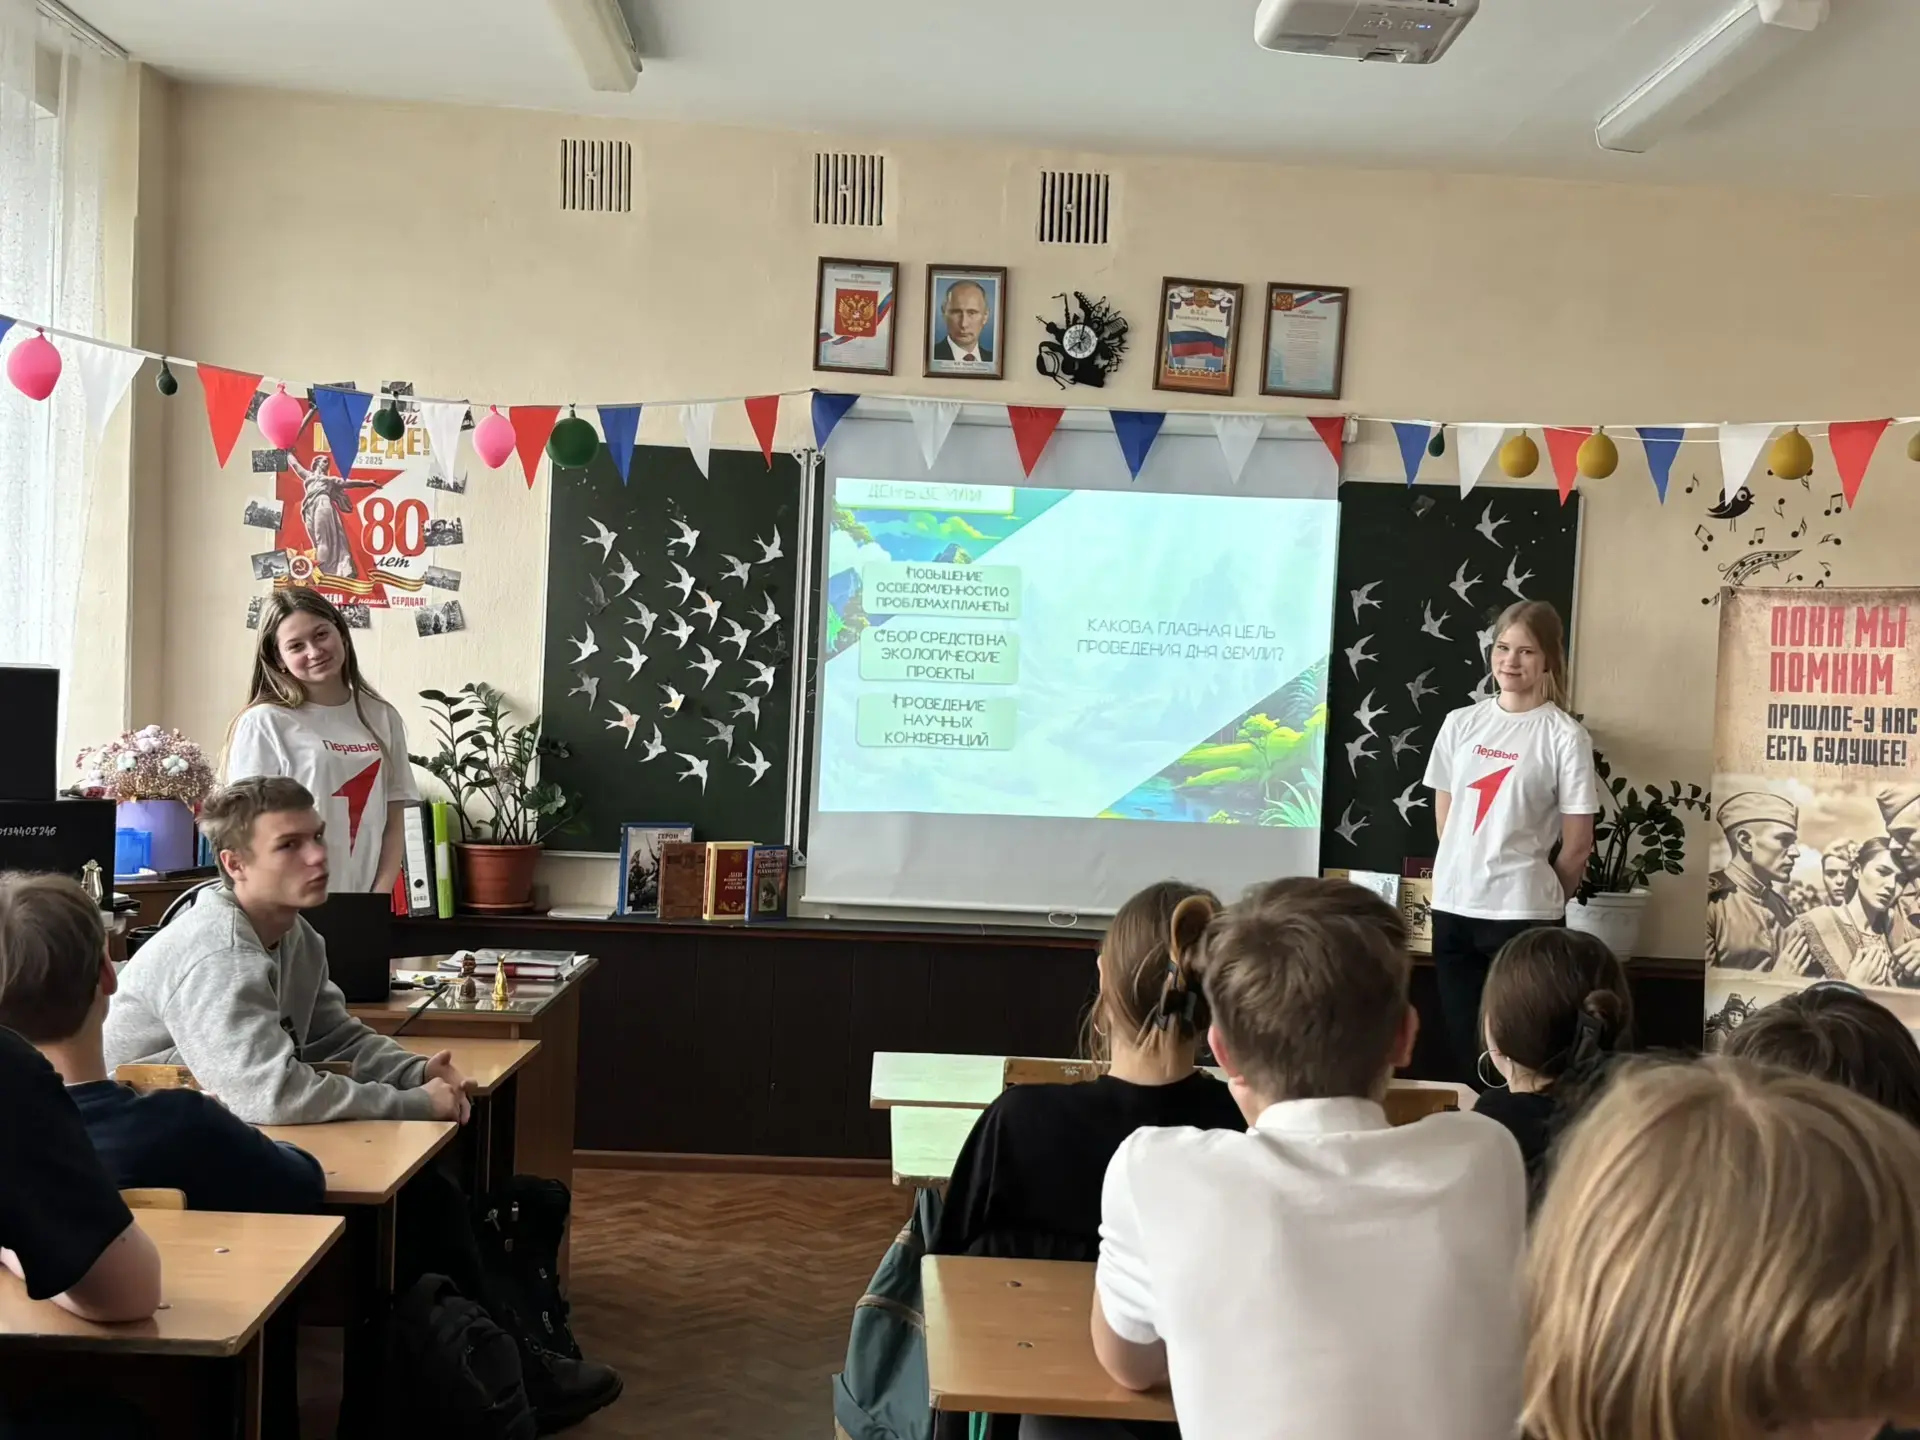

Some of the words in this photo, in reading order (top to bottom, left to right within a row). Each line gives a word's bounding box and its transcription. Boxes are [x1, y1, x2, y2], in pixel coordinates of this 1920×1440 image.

[362, 496, 430, 558] 80
[373, 554, 410, 568] лет
[906, 567, 983, 582] ПОВЫШЕНИЕ
[876, 581, 998, 597] ОСВЕДОМЛЕННОСТИ
[1000, 587, 1010, 598] О
[391, 596, 427, 607] СЕРДЦАХ!
[876, 596, 950, 610] ПРОБЛЕМАХ
[951, 599, 1010, 612] ПЛАНЕТЫ
[1087, 618, 1154, 635] КАКОВА
[1157, 620, 1231, 638] ГЛАВНАЯ
[1234, 624, 1276, 640] ЦЕЛЬ
[1770, 605, 1846, 648] ПОКА
[1855, 606, 1908, 648] МЫ
[873, 630, 917, 643] СБОР
[920, 631, 984, 646] СРЕДСТВ
[986, 634, 1008, 647] НА
[881, 647, 1001, 664] ЭКОЛОГИЧЕСКИЕ
[1077, 638, 1181, 657] ПРОВЕДЕНИЯ
[1184, 643, 1218, 660] ДНЯ
[1221, 645, 1285, 662] ЗЕМЛИ?
[906, 665, 975, 680] ПРОЕКТЫ
[1769, 651, 1895, 696] ПОМНИМ
[893, 695, 986, 712] ПРОВЕДЕНИЕ
[903, 713, 973, 729] НАУЧНЫХ
[1881, 706, 1919, 735] НАС
[322, 739, 381, 756] Первые
[884, 731, 989, 747] КОНФЕРЕНЦИЙ
[1472, 744, 1519, 761] Первые
[1766, 735, 1807, 762] ЕСТЬ
[1813, 736, 1908, 768] БУДУЩЕЕ!
